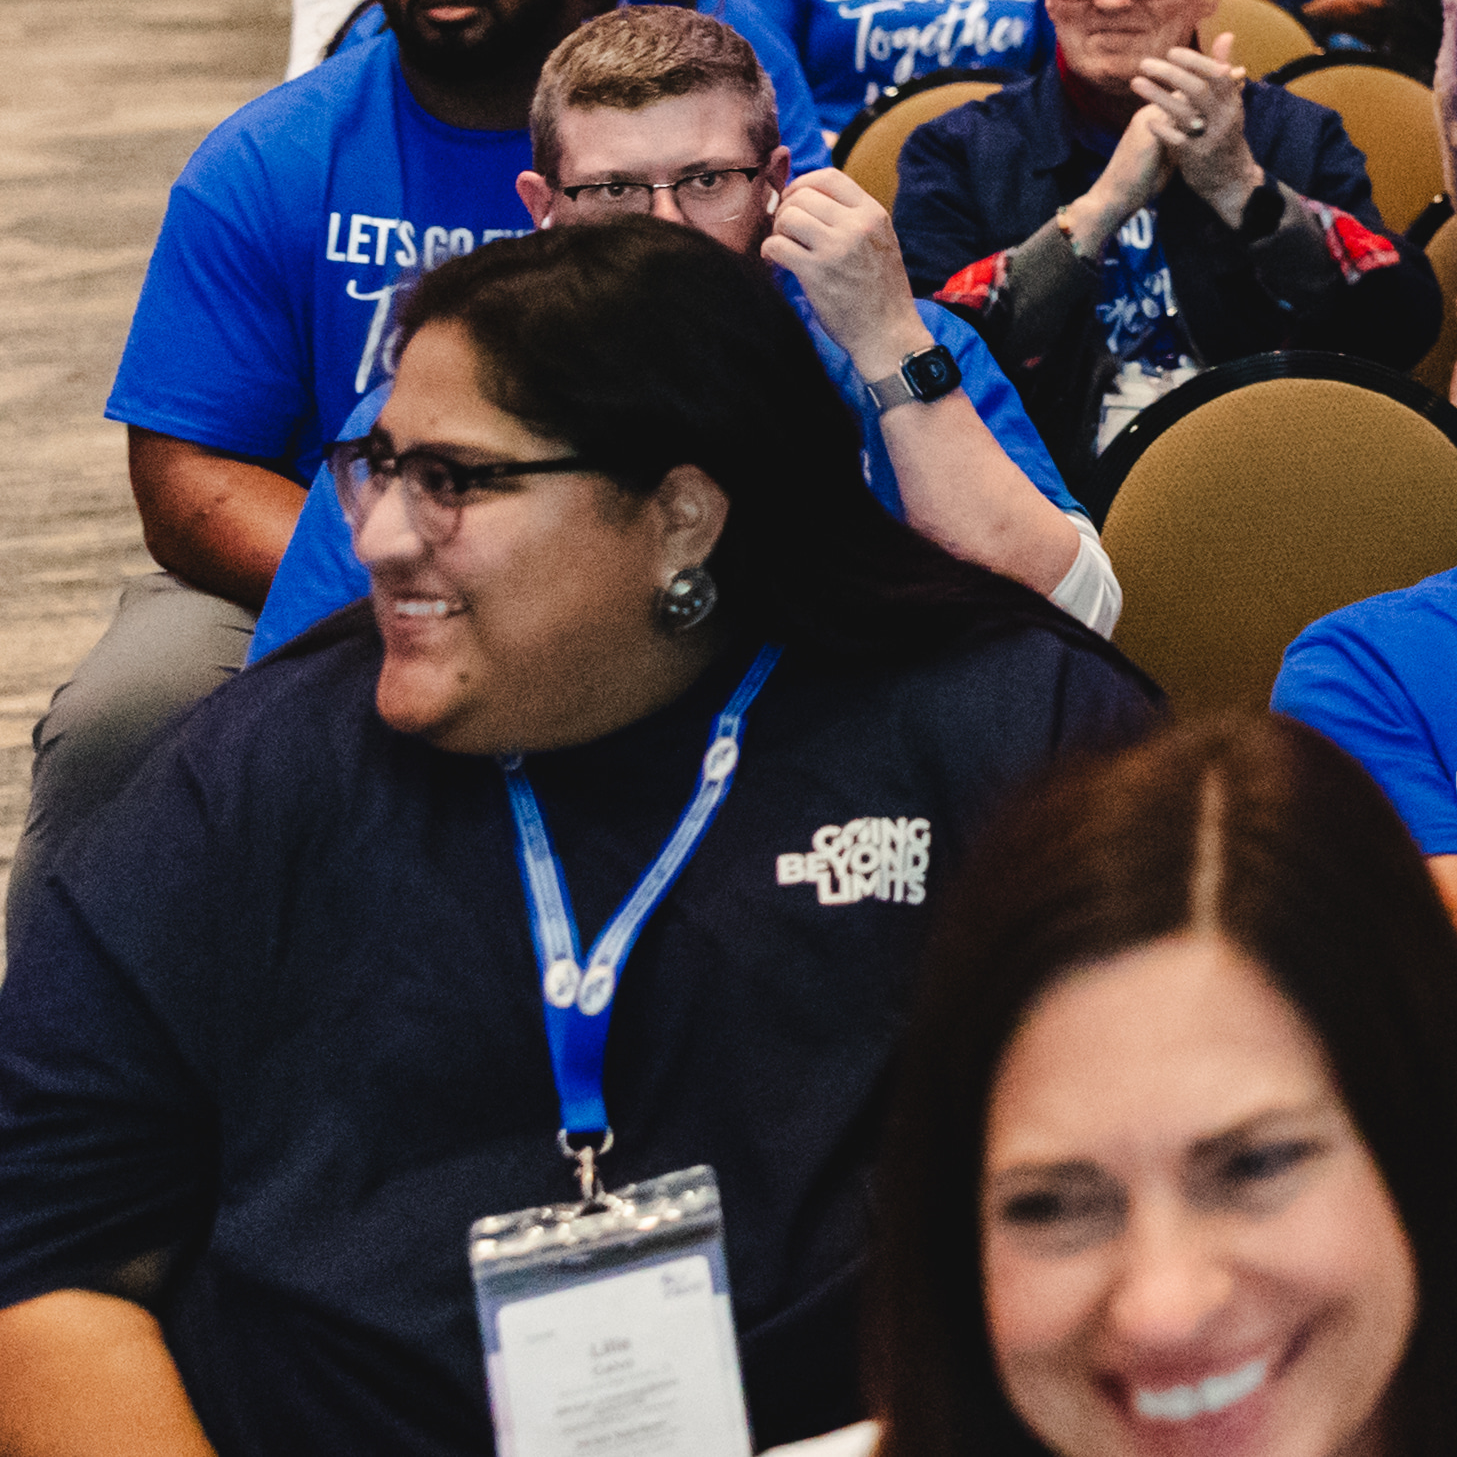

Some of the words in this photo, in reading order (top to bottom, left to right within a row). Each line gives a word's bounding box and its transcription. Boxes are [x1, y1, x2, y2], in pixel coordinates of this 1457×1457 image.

[812, 816, 932, 854] GOING
[776, 844, 930, 886] BEYOND
[816, 872, 927, 906] LIMITS
